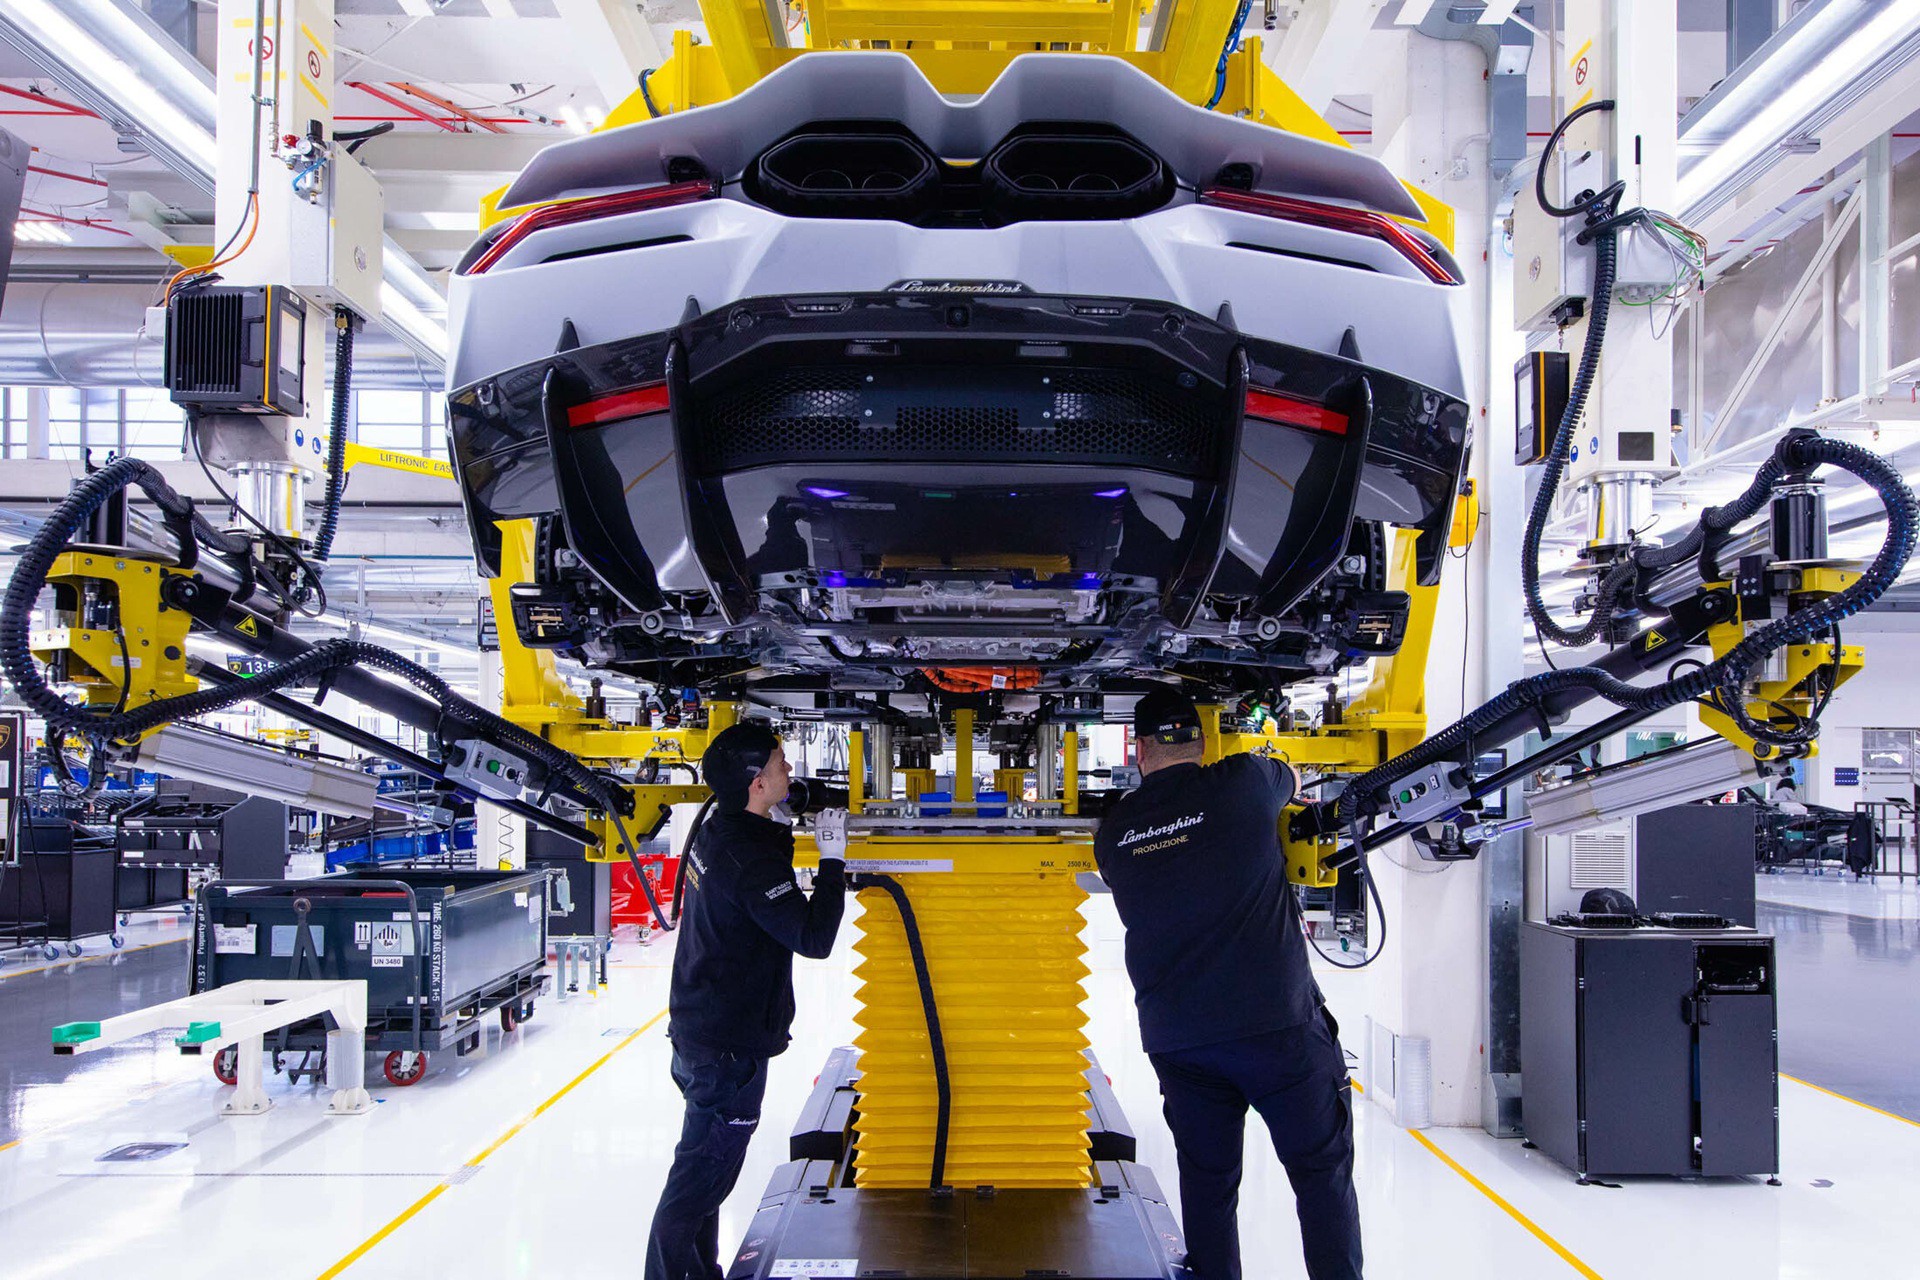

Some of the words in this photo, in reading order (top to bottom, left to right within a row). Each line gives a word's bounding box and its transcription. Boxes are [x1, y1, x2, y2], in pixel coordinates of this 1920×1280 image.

[888, 280, 1022, 293] Lamborghini
[380, 453, 428, 469] LIFTRONIC
[433, 462, 452, 474] EAS
[822, 830, 834, 841] B
[1117, 812, 1204, 847] Lamborghini
[1132, 834, 1190, 856] PRODUZIONE
[197, 912, 206, 922] of
[197, 922, 206, 955] Property
[432, 924, 442, 940] 260
[432, 941, 441, 953] KG
